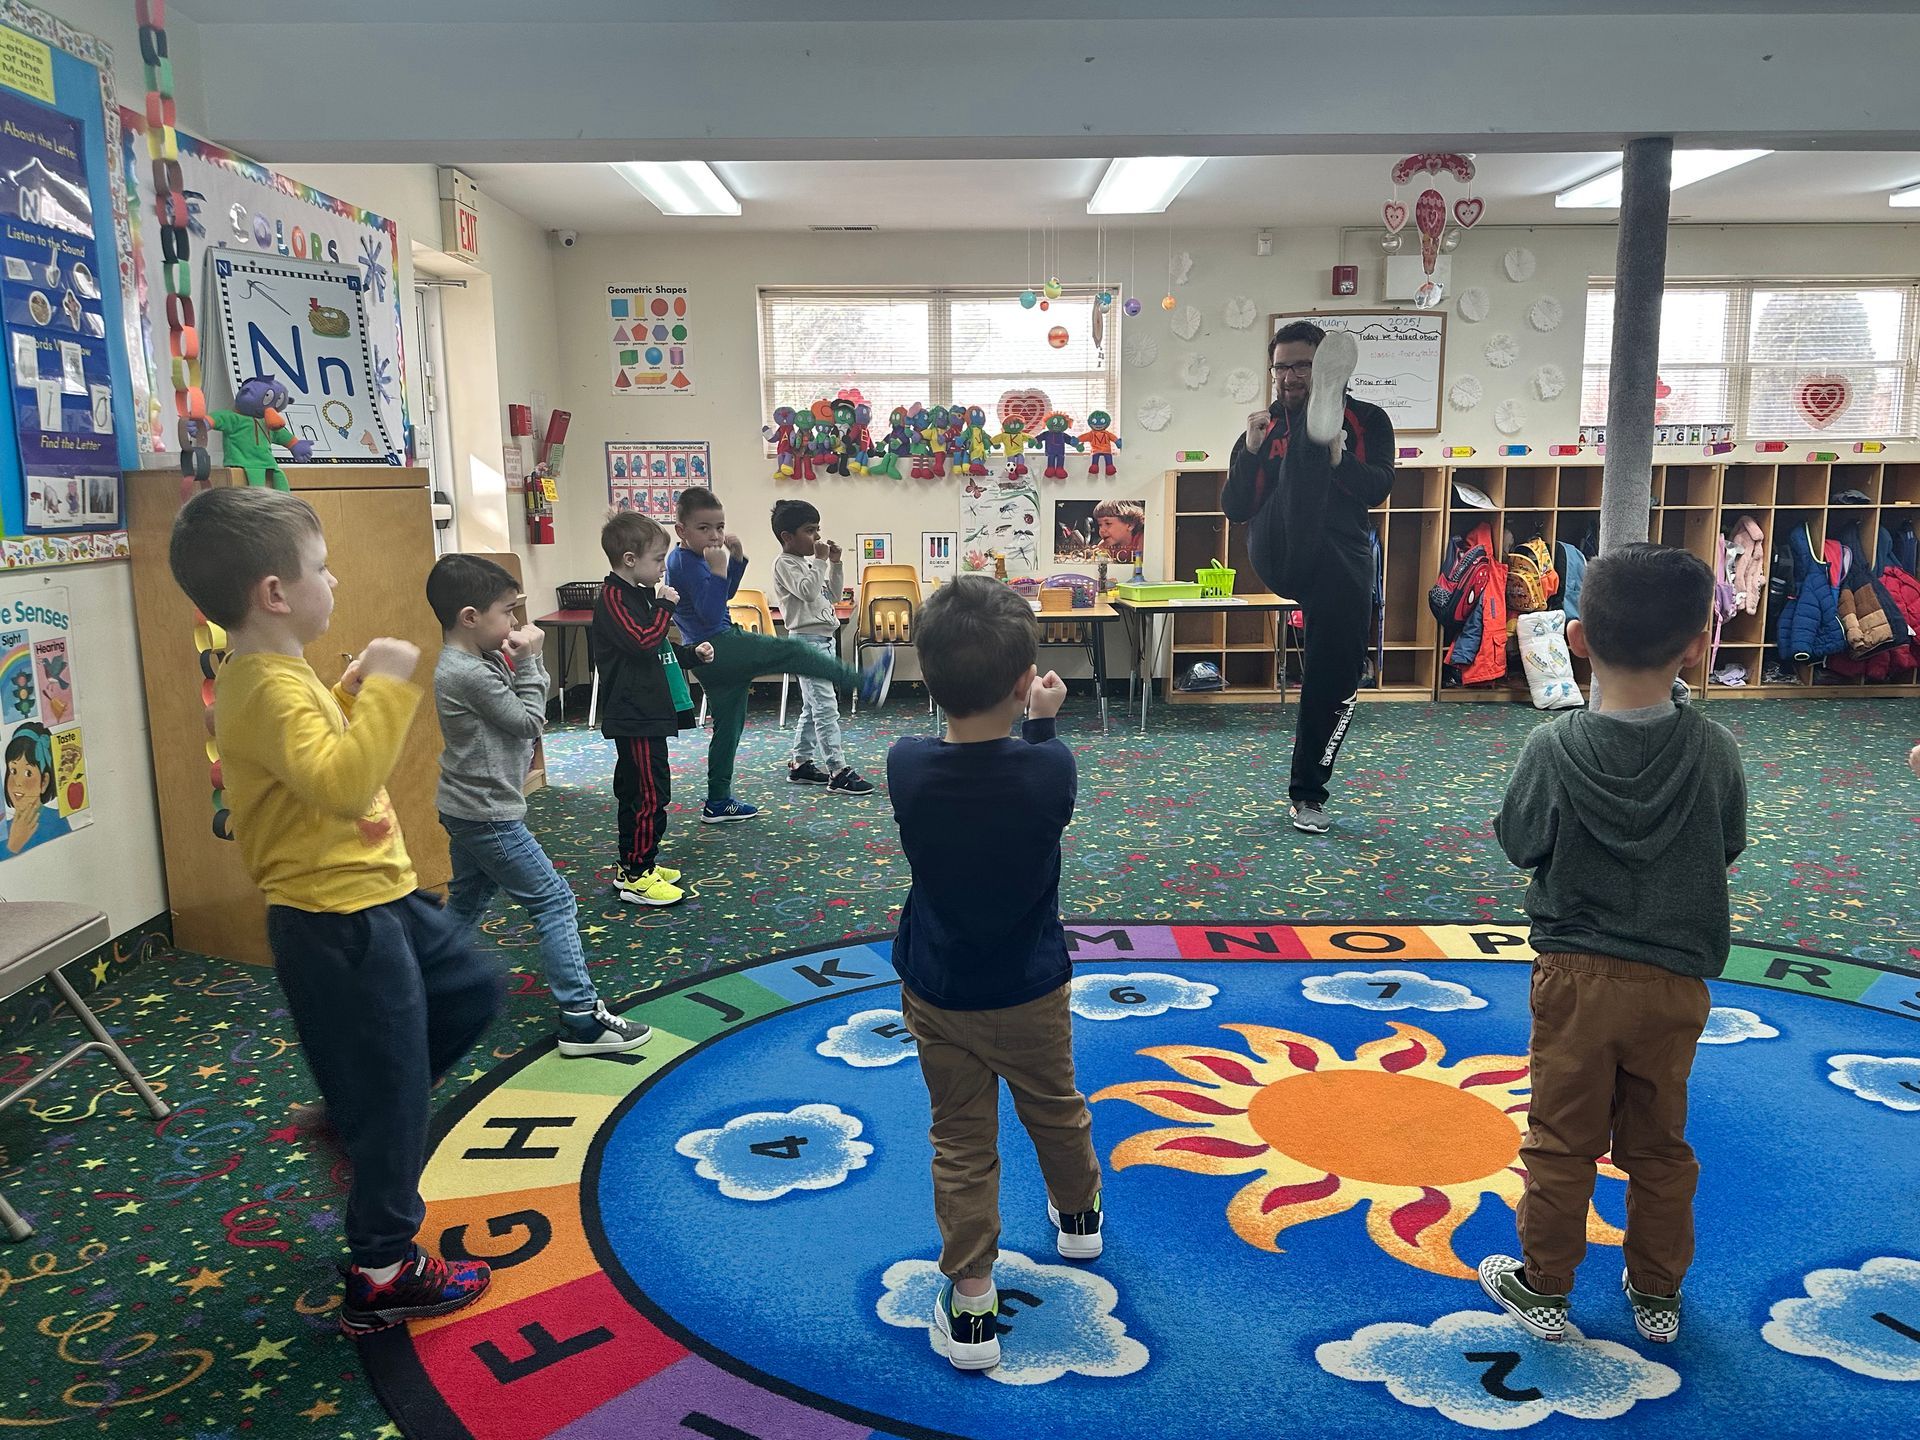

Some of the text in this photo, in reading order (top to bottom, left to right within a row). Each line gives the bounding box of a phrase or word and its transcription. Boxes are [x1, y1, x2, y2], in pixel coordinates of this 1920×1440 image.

[2, 61, 45, 87] Month
[3, 53, 41, 74] of the
[4, 120, 35, 144] About
[37, 133, 53, 150] the
[7, 225, 85, 258] Listen to the Sound
[229, 203, 340, 264] COLORS
[459, 208, 478, 255] EXIT
[608, 285, 687, 295] Geometric Shapes
[1389, 317, 1421, 328] 2025!
[1360, 333, 1379, 341] Today
[1395, 333, 1417, 341] talked
[40, 434, 101, 450] Find the Letter
[1010, 434, 1019, 447] K
[1094, 433, 1107, 444] M
[1578, 434, 1586, 443] A
[1597, 434, 1604, 443] B
[1661, 433, 1667, 442] F
[1676, 432, 1684, 442] G
[1691, 432, 1699, 442] H
[15, 601, 69, 630] Senses
[2, 633, 22, 648] Sight
[35, 641, 65, 655] Hearing
[56, 732, 76, 745] Taste
[1067, 930, 1135, 952] M
[1205, 932, 1281, 953] N
[1329, 931, 1406, 953] O
[1469, 932, 1528, 954] P
[792, 957, 873, 988] K
[1764, 958, 1832, 989] R
[1109, 985, 1147, 1005] 6
[1366, 981, 1401, 999] 7
[683, 991, 745, 1023] J
[461, 1116, 577, 1160] H
[749, 1135, 809, 1160] 4
[439, 1209, 552, 1271] G
[471, 1320, 614, 1385] F
[1463, 1351, 1544, 1401] 2
